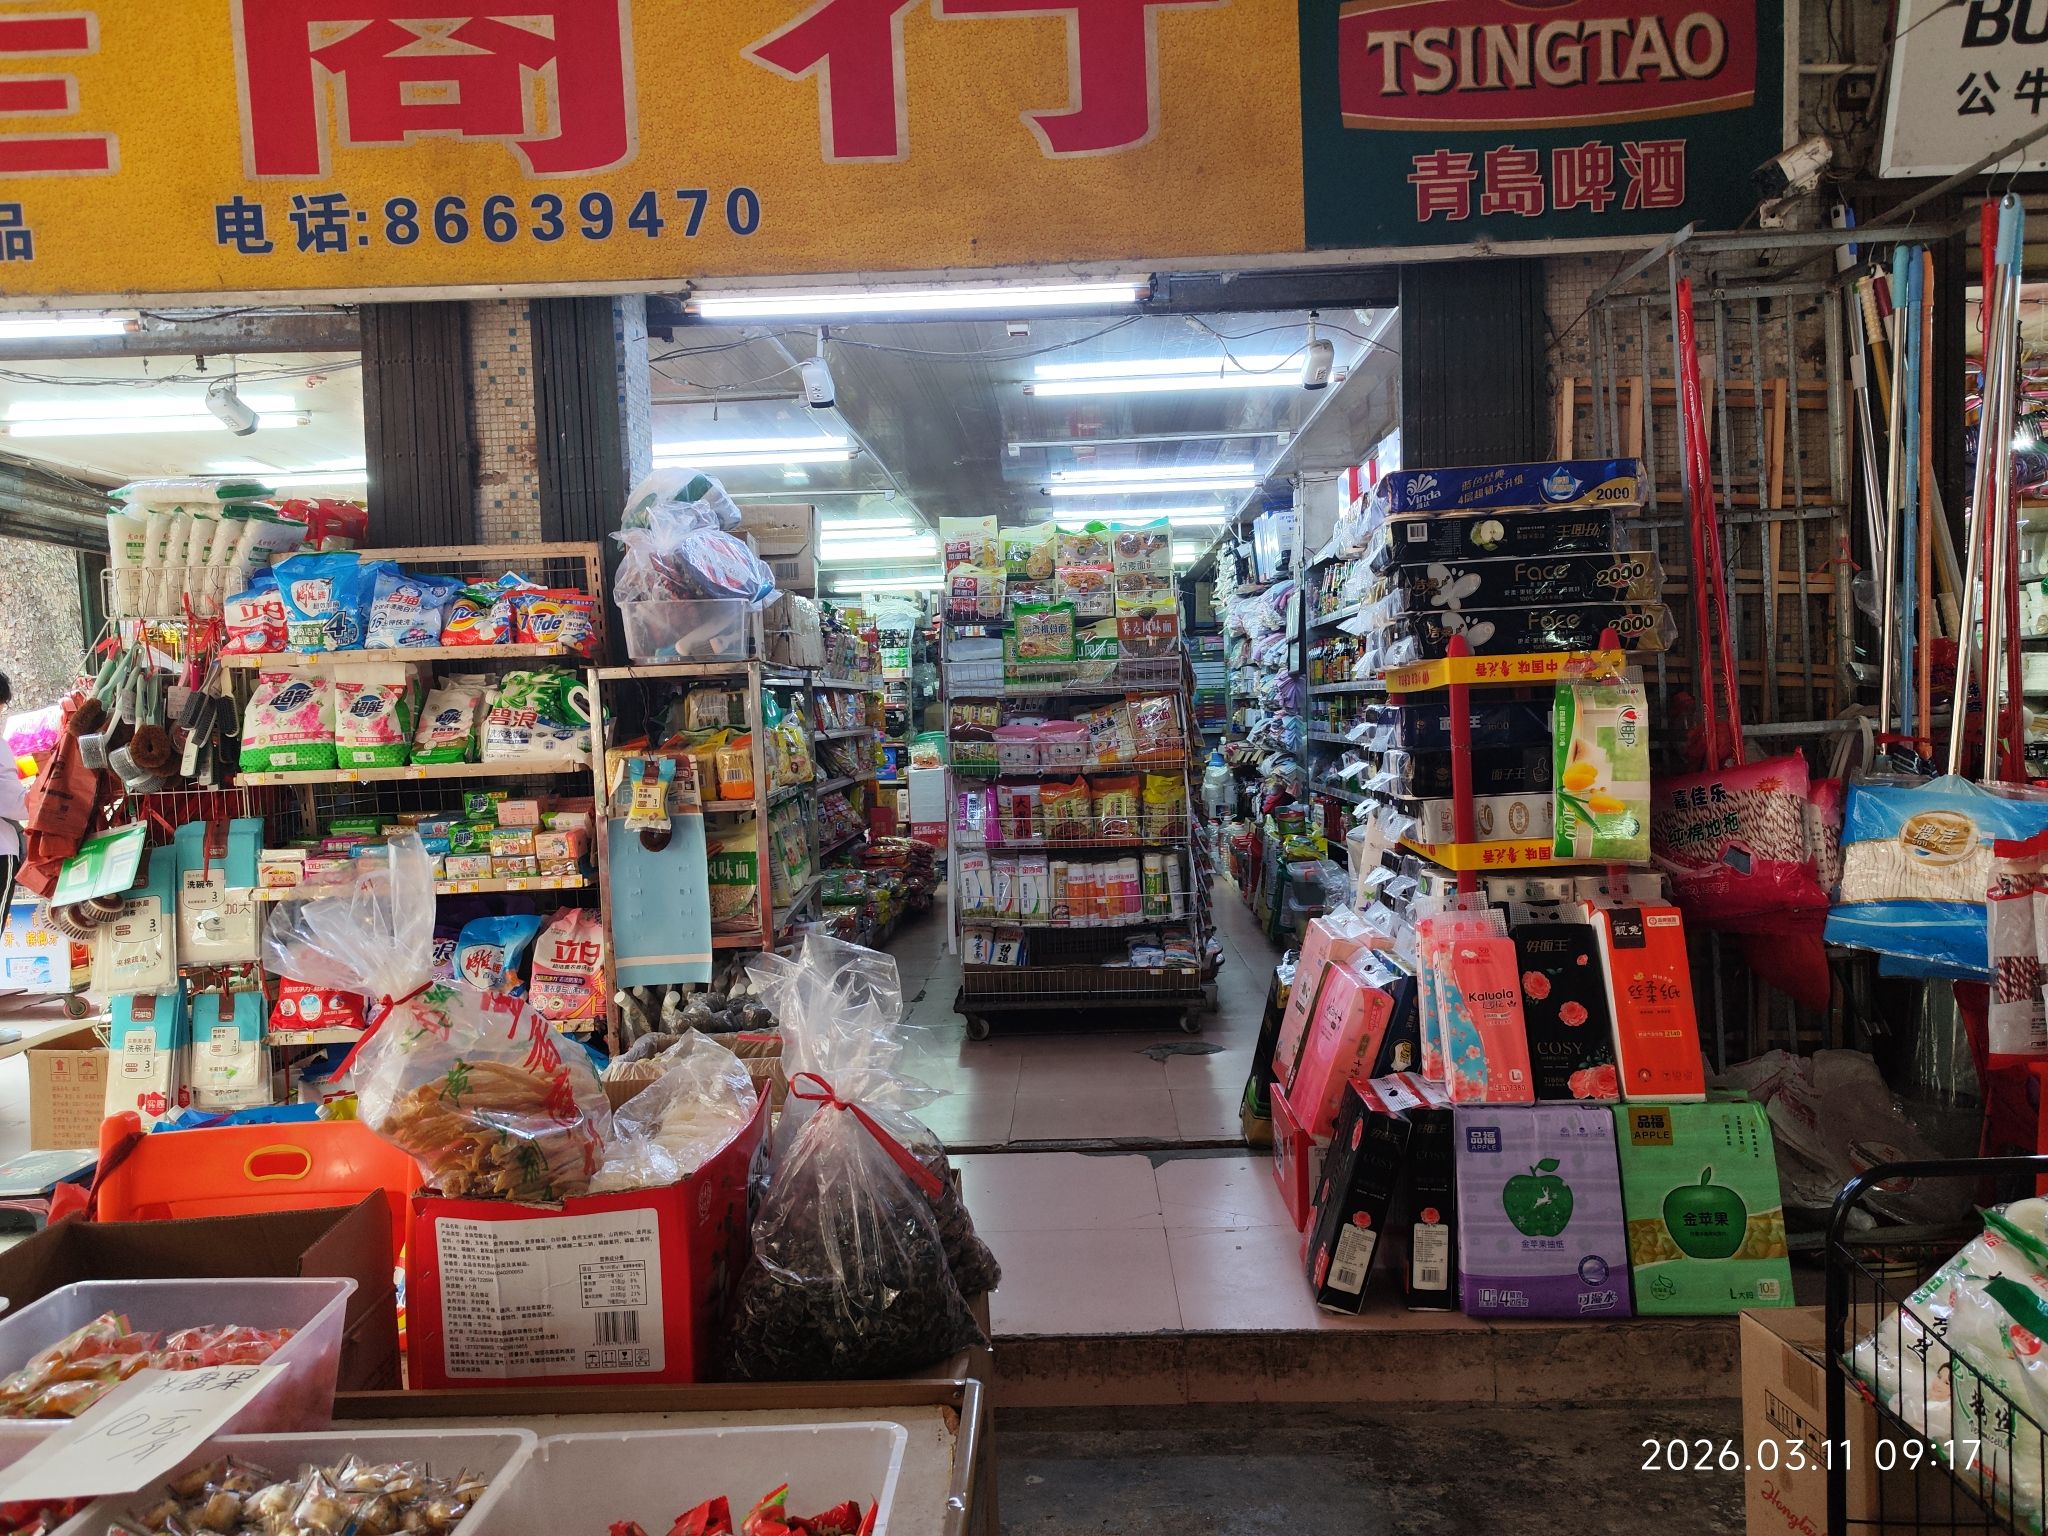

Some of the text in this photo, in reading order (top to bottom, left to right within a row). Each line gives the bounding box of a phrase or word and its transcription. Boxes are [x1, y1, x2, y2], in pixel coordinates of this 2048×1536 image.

[1366, 10, 1728, 97] TSINGTAO
[0, 0, 1222, 180] 商行
[1956, 66, 2048, 117] 公牛
[1406, 489, 1442, 506] Vinda
[1596, 487, 1630, 500] 2000
[1514, 562, 1571, 582] Face
[1596, 563, 1646, 588] 2000
[239, 600, 284, 623] 立白
[532, 613, 562, 632] Tide
[1527, 612, 1582, 631] Face
[269, 687, 317, 708] 超能
[350, 699, 386, 714] 超能
[489, 707, 539, 730] 碧浪
[1671, 783, 1727, 810] 嘉佳乐
[1562, 809, 1578, 841] 1000
[1667, 811, 1740, 849] 纯棉地拖
[187, 880, 214, 889] 洗碗布
[212, 891, 218, 900] 3
[224, 903, 252, 915] 加大
[149, 918, 156, 929] 3
[550, 939, 601, 967] 立白
[1526, 939, 1569, 953] 好面王
[1468, 988, 1515, 1003] Kaluola
[1537, 1041, 1585, 1056] COSY
[144, 1060, 151, 1069] 3
[1637, 1114, 1665, 1129] 品福
[1470, 1131, 1497, 1145] 品福
[1634, 1130, 1671, 1139] APPLE
[1682, 1211, 1729, 1227] 金苹果
[1520, 1239, 1565, 1249] 金苹果抽纸
